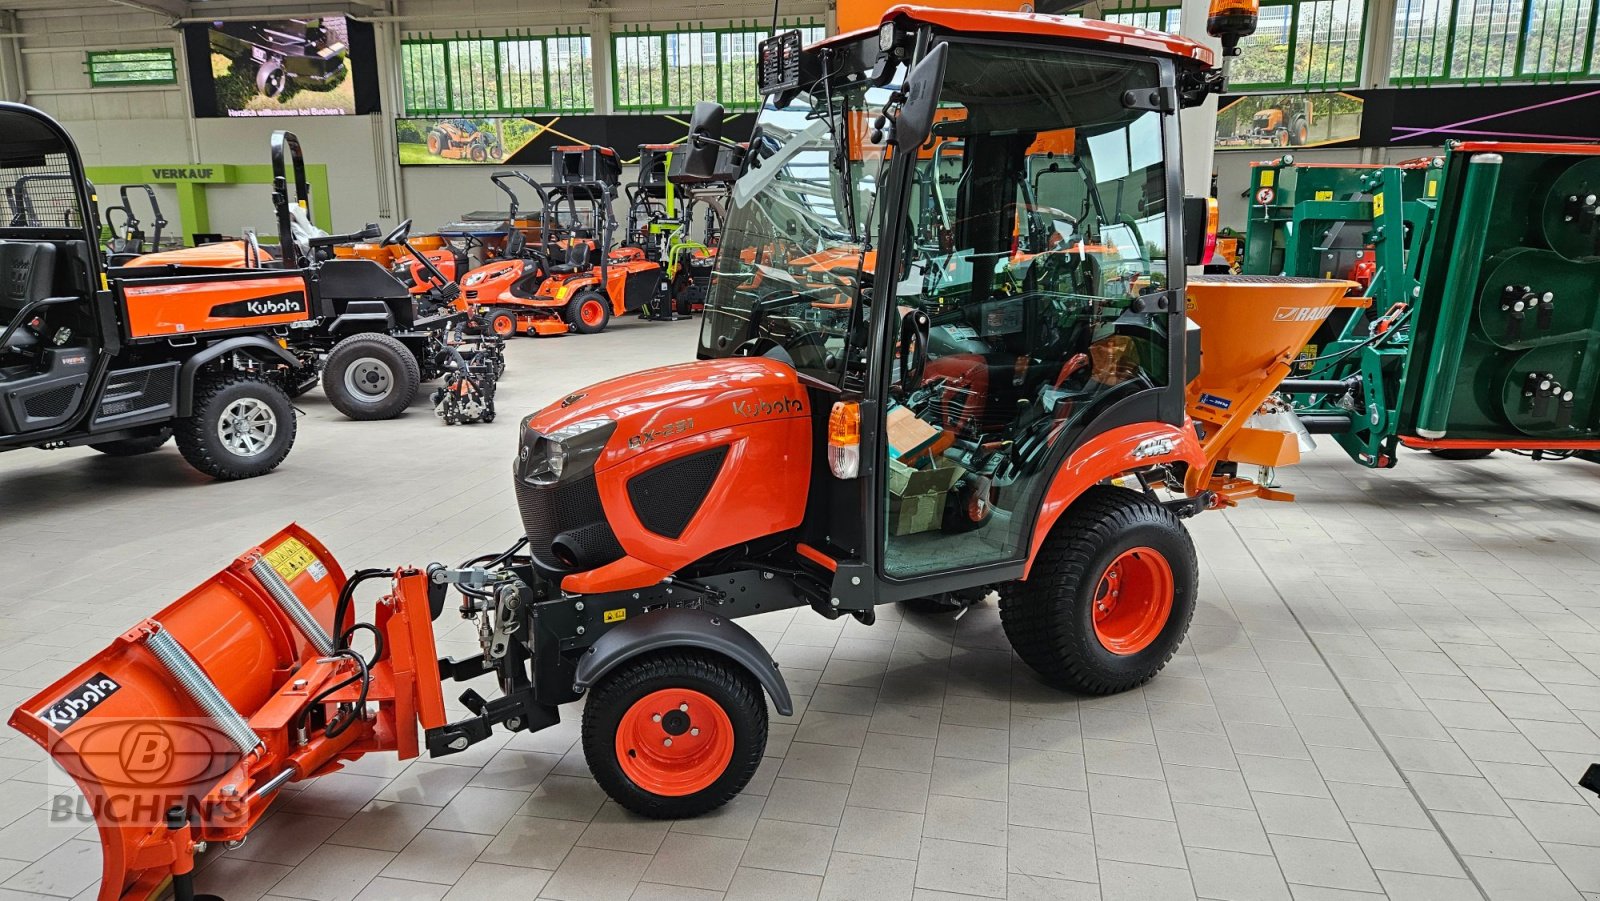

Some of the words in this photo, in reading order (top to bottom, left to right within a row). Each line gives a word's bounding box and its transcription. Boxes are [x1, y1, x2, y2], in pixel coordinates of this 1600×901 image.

[152, 168, 213, 179] VERKAUF
[247, 298, 301, 315] Kubota
[732, 395, 803, 418] Kubota
[39, 679, 118, 727] Kubota
